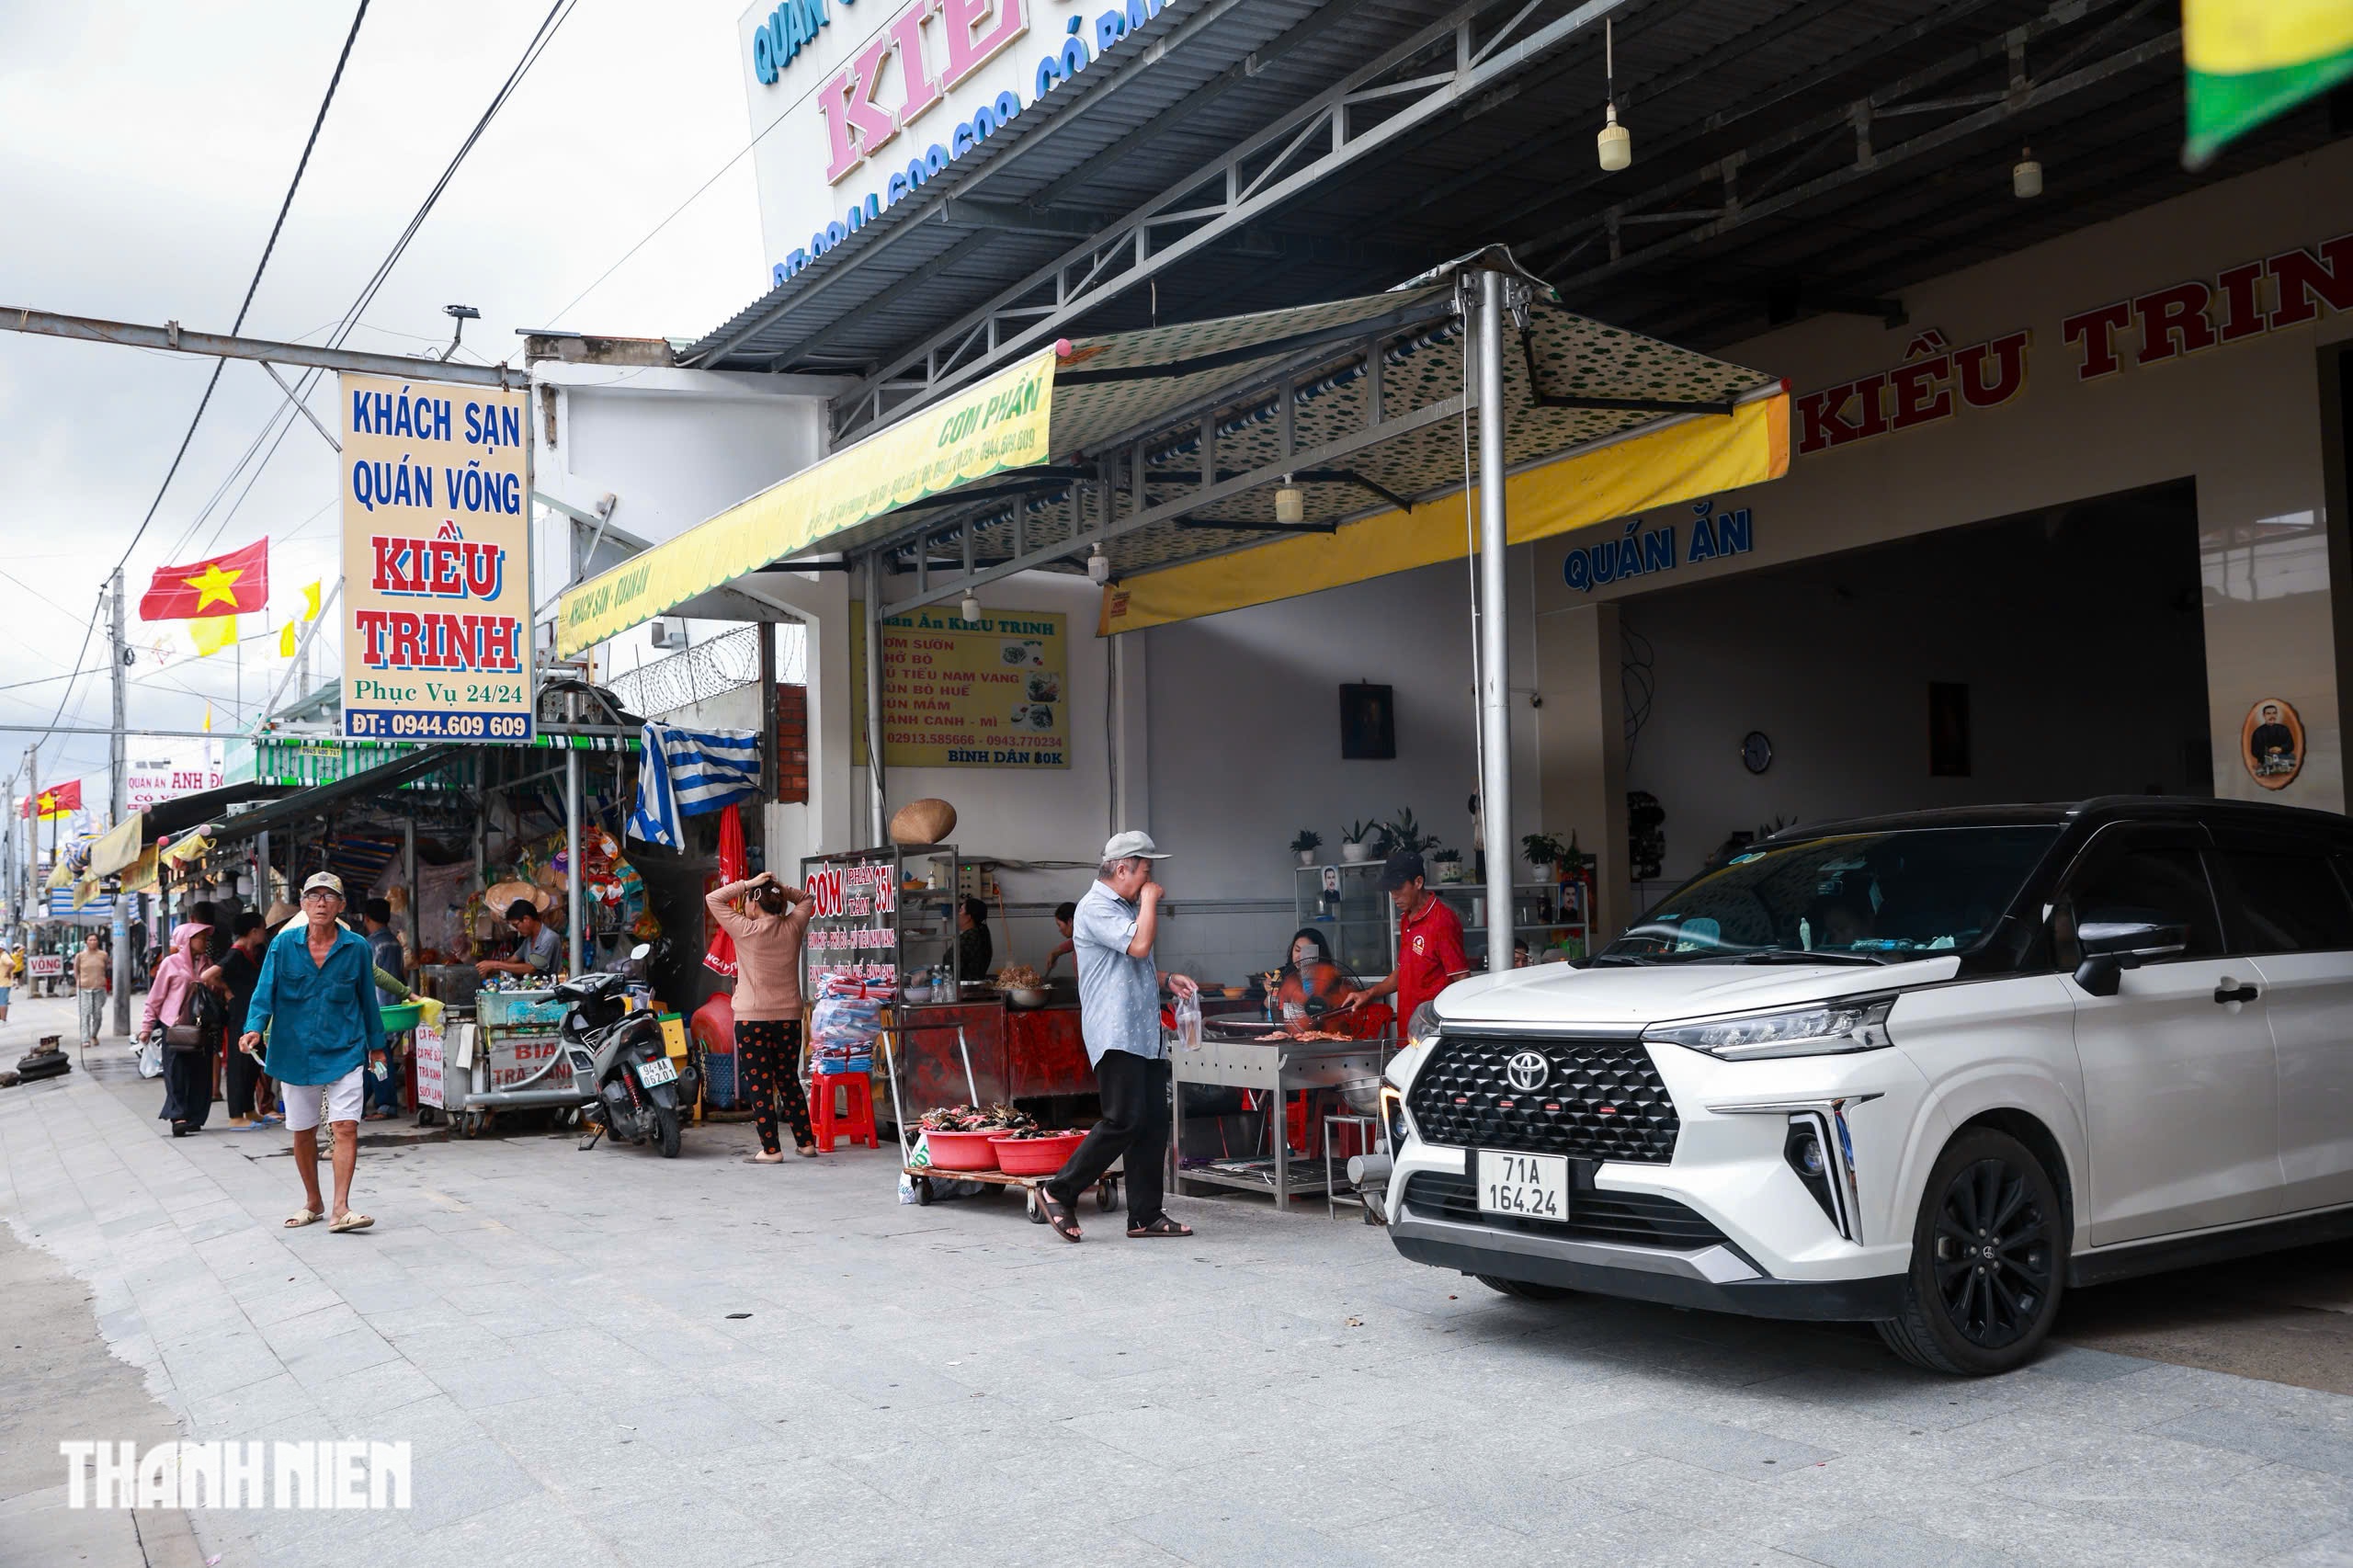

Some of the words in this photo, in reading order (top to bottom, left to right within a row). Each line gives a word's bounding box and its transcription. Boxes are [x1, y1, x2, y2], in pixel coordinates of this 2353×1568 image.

[1795, 328, 2030, 457] KIỀU
[353, 384, 451, 442] KHÁCH
[464, 402, 520, 454] SẠN
[353, 453, 433, 512] QUÁN
[445, 461, 521, 515] VÕNG
[1563, 519, 1676, 593] QUÁN
[1687, 501, 1752, 563] ĂN
[371, 519, 505, 602] KIỀU
[998, 619, 1055, 635] TRINH
[356, 610, 522, 673] TRINH
[883, 637, 908, 648] ƠM
[884, 651, 906, 664] HỞ
[882, 682, 907, 693] ÚN
[943, 671, 976, 682] NAM
[981, 673, 1019, 684] VANG
[355, 680, 417, 706] Phục
[426, 683, 458, 703] Vụ
[467, 685, 523, 704] 24/24
[352, 714, 385, 734] ĐT:
[391, 714, 484, 736] 0944.609
[489, 716, 526, 736] 609
[924, 716, 964, 726] CANH
[980, 717, 997, 727] MÌ
[948, 746, 990, 762] BÌNH
[994, 748, 1029, 763] DÂN
[172, 772, 203, 789] ANH
[875, 865, 895, 914] 35K
[848, 890, 870, 916] TẤM
[515, 1042, 557, 1061] BIA
[493, 1063, 527, 1085] TRÀ
[642, 1060, 668, 1075] 94-AA
[644, 1071, 676, 1086] 062.01
[1503, 1156, 1540, 1184] 71A
[1490, 1185, 1557, 1216] 164.24
